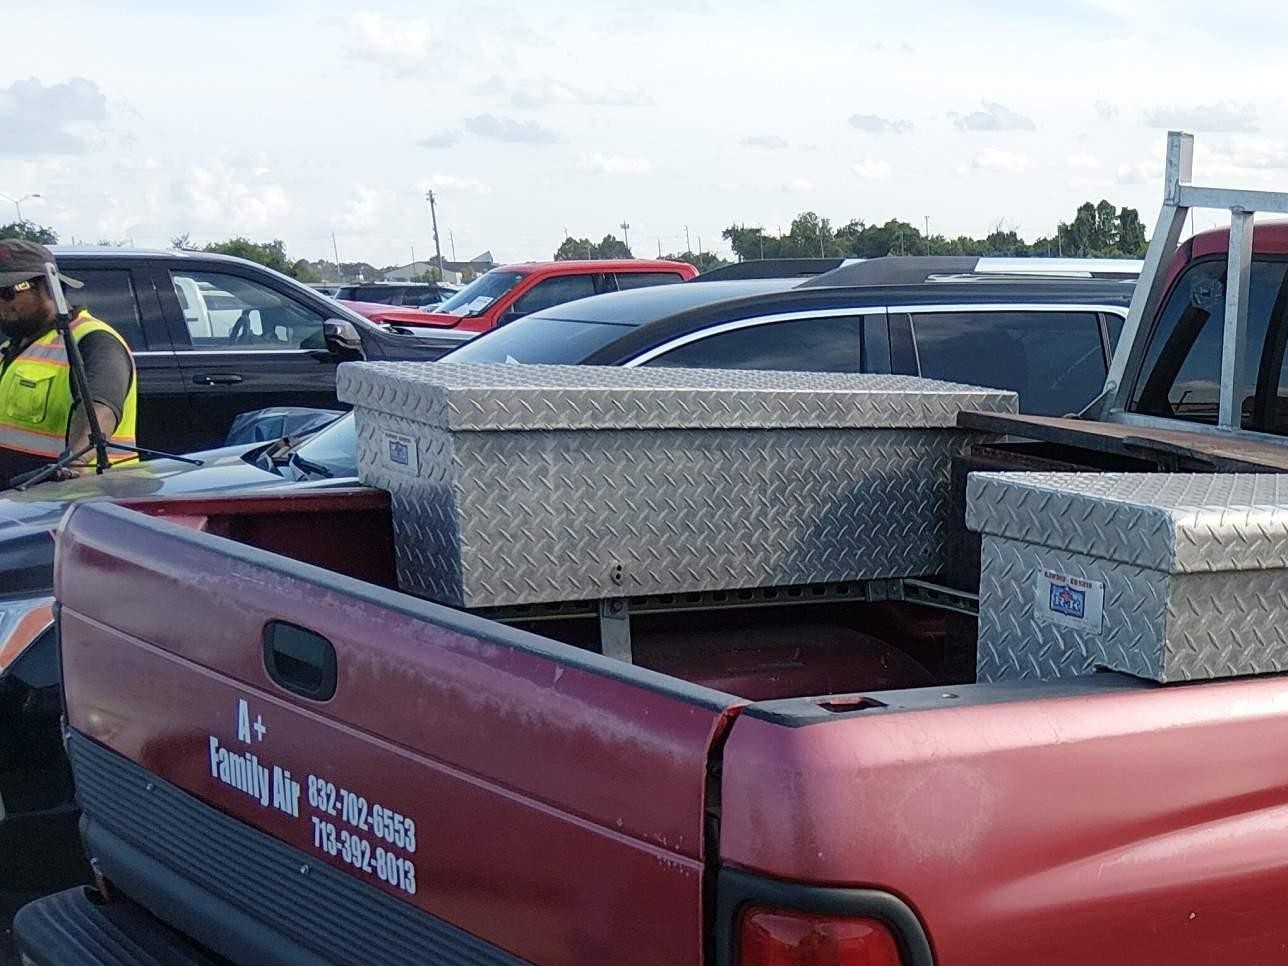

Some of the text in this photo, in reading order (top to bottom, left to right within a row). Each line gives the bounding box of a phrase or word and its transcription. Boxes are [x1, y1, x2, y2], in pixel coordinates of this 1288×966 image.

[237, 698, 267, 744] A+
[209, 735, 300, 818] Family Air
[307, 774, 416, 853] 832-702-6553
[311, 816, 417, 894] 713-392-8013
